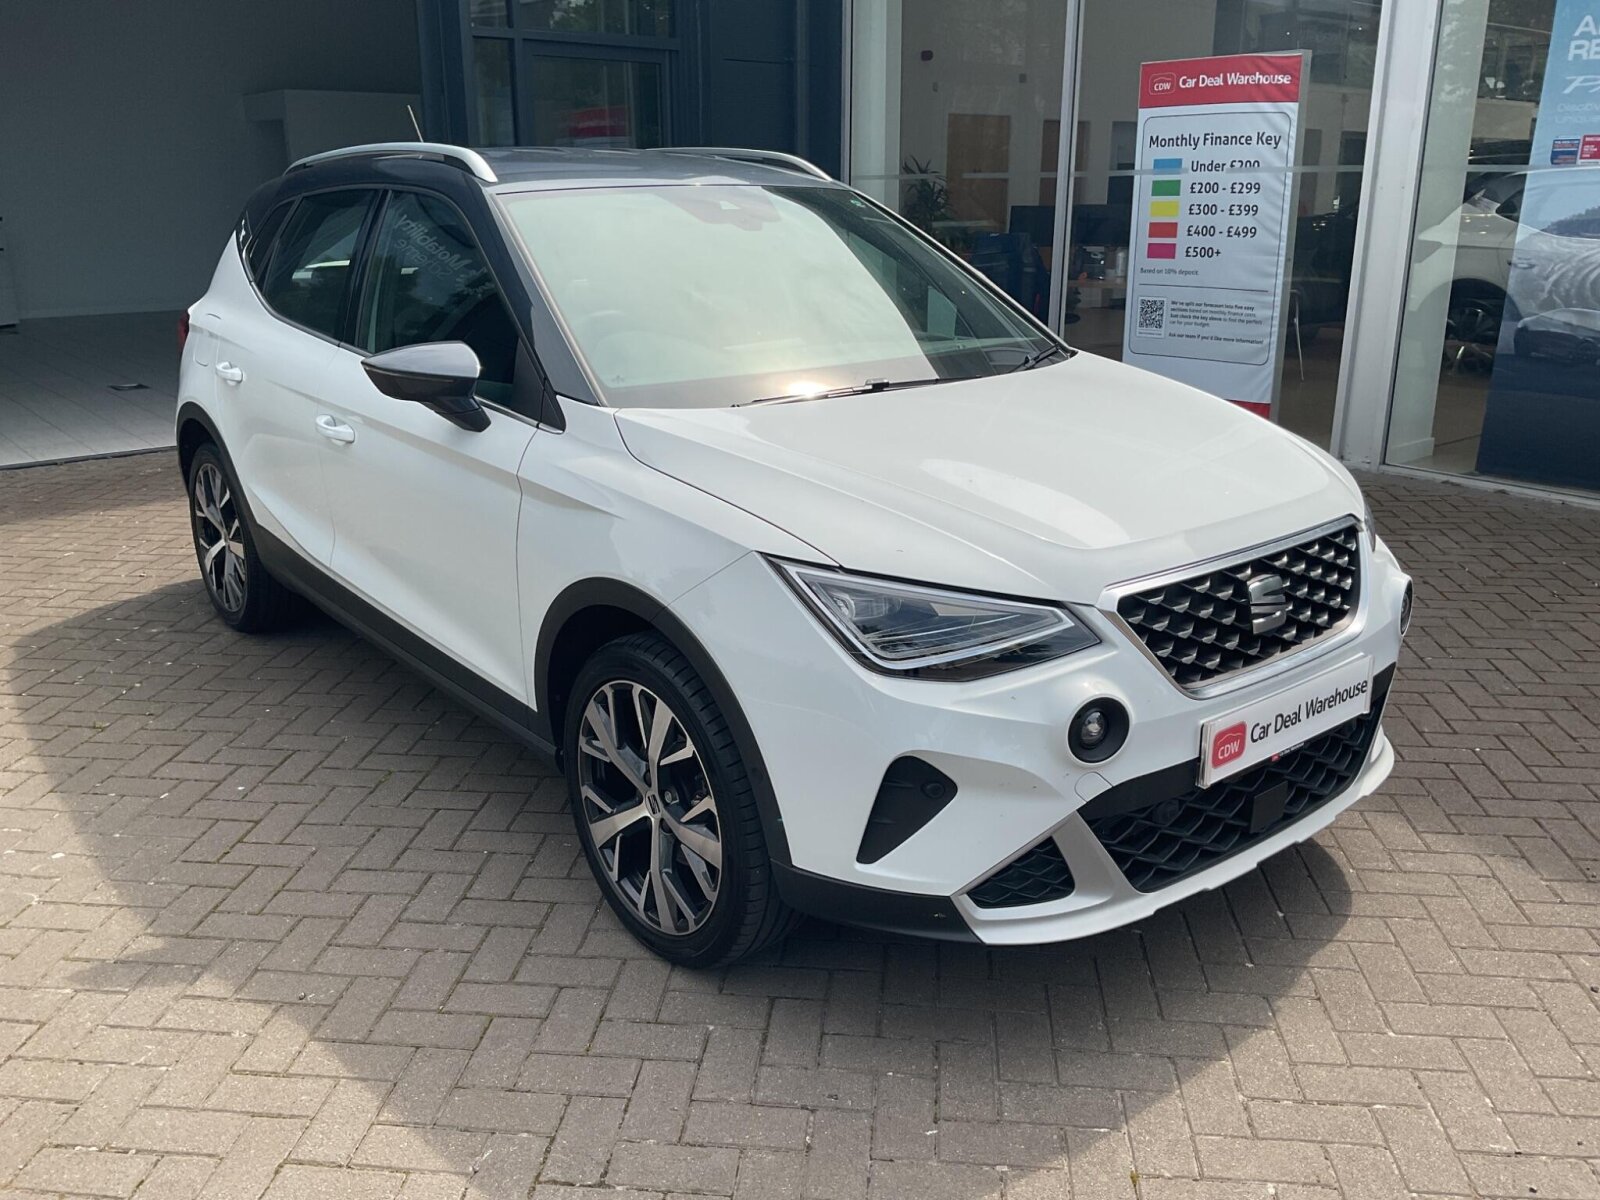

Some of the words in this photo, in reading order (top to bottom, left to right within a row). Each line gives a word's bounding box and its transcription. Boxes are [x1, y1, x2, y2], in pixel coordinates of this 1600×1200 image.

[1178, 76, 1196, 88] Car
[1199, 72, 1224, 88] Deal
[1226, 72, 1292, 86] Warehouse
[1154, 82, 1172, 91] CDW
[1150, 134, 1200, 150] Monthly
[1202, 132, 1252, 146] Finance
[1256, 132, 1282, 149] Key
[1190, 160, 1226, 172] Under
[1190, 182, 1219, 194] £200
[1230, 182, 1261, 194] £299
[1188, 204, 1218, 216] £300
[1228, 204, 1258, 216] £399
[1186, 225, 1216, 237] £400
[1226, 226, 1257, 238] £499
[1185, 246, 1221, 258] £500+
[1250, 722, 1272, 743] Car
[1274, 705, 1302, 734] Deal
[1305, 680, 1368, 720] Warehouse
[1218, 740, 1240, 760] CDW
